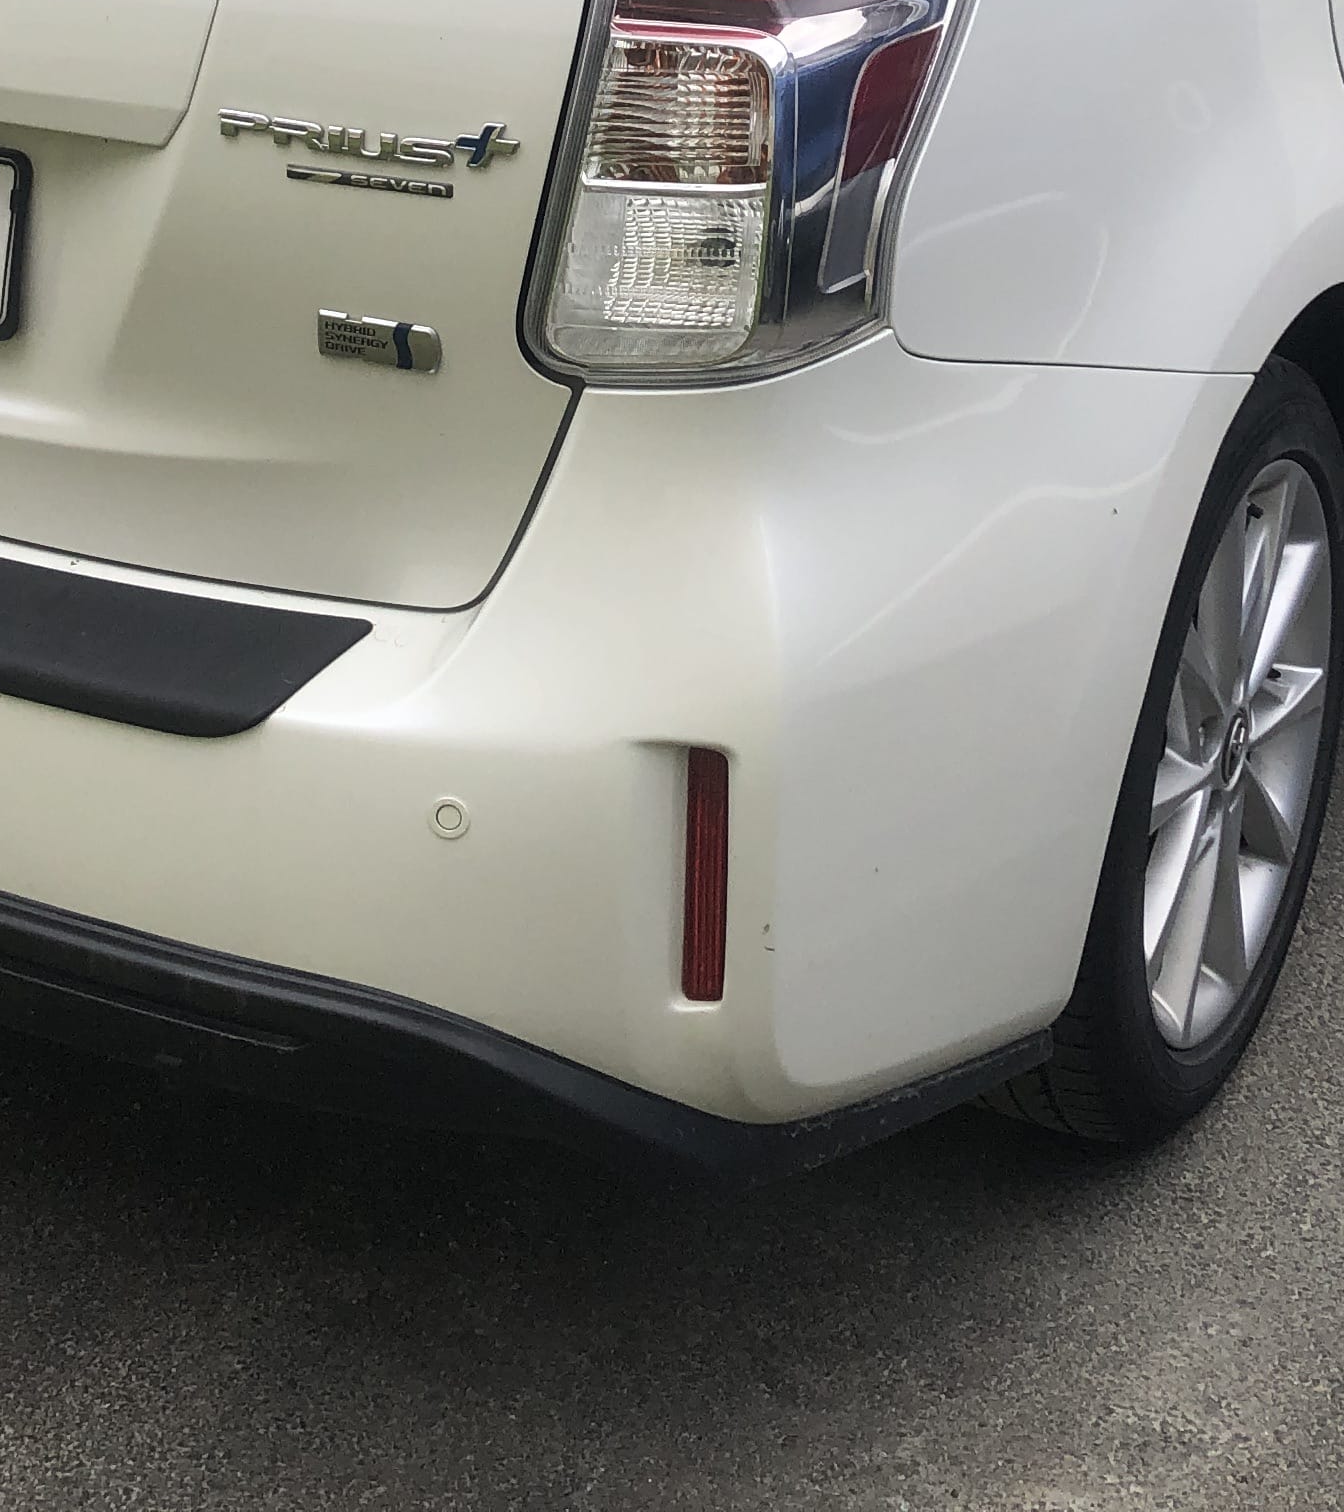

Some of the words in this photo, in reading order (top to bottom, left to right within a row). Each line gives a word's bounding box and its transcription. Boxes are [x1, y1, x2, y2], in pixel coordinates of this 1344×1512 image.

[350, 174, 447, 197] SEVEN
[324, 321, 376, 337] HYBRID
[324, 330, 389, 349] SYNERGY
[324, 341, 366, 355] DRIVE
